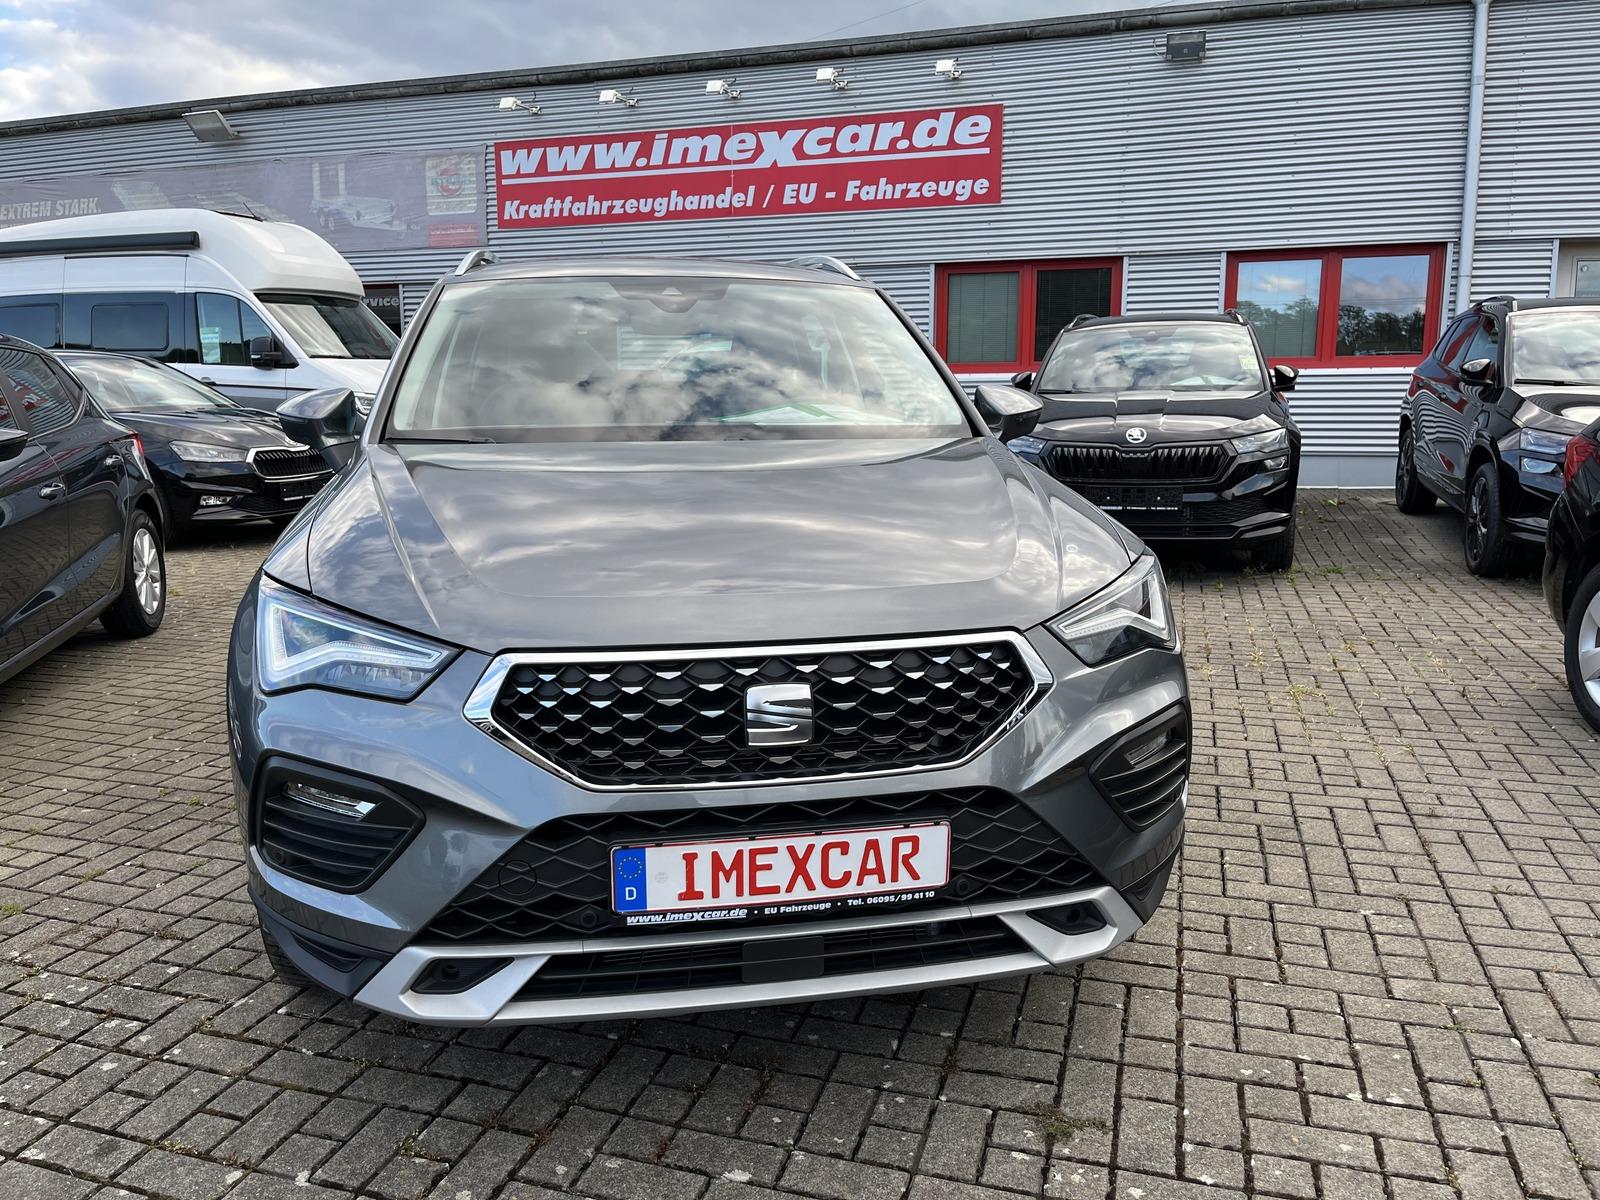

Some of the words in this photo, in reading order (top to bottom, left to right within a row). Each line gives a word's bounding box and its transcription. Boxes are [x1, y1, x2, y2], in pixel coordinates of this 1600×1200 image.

[500, 111, 992, 176] www.imexcar.de
[0, 201, 52, 220] EXTREM
[503, 185, 755, 221] Kraftfahrzeughandel
[782, 181, 817, 206] EU
[845, 177, 990, 203] Fahrzeuge
[677, 834, 921, 901] IMEXCAR
[625, 886, 637, 900] D
[626, 908, 748, 925] www.imexcar.de
[764, 907, 778, 915] EU
[780, 901, 832, 913] Fahrzeuge
[847, 898, 864, 906] Tel.
